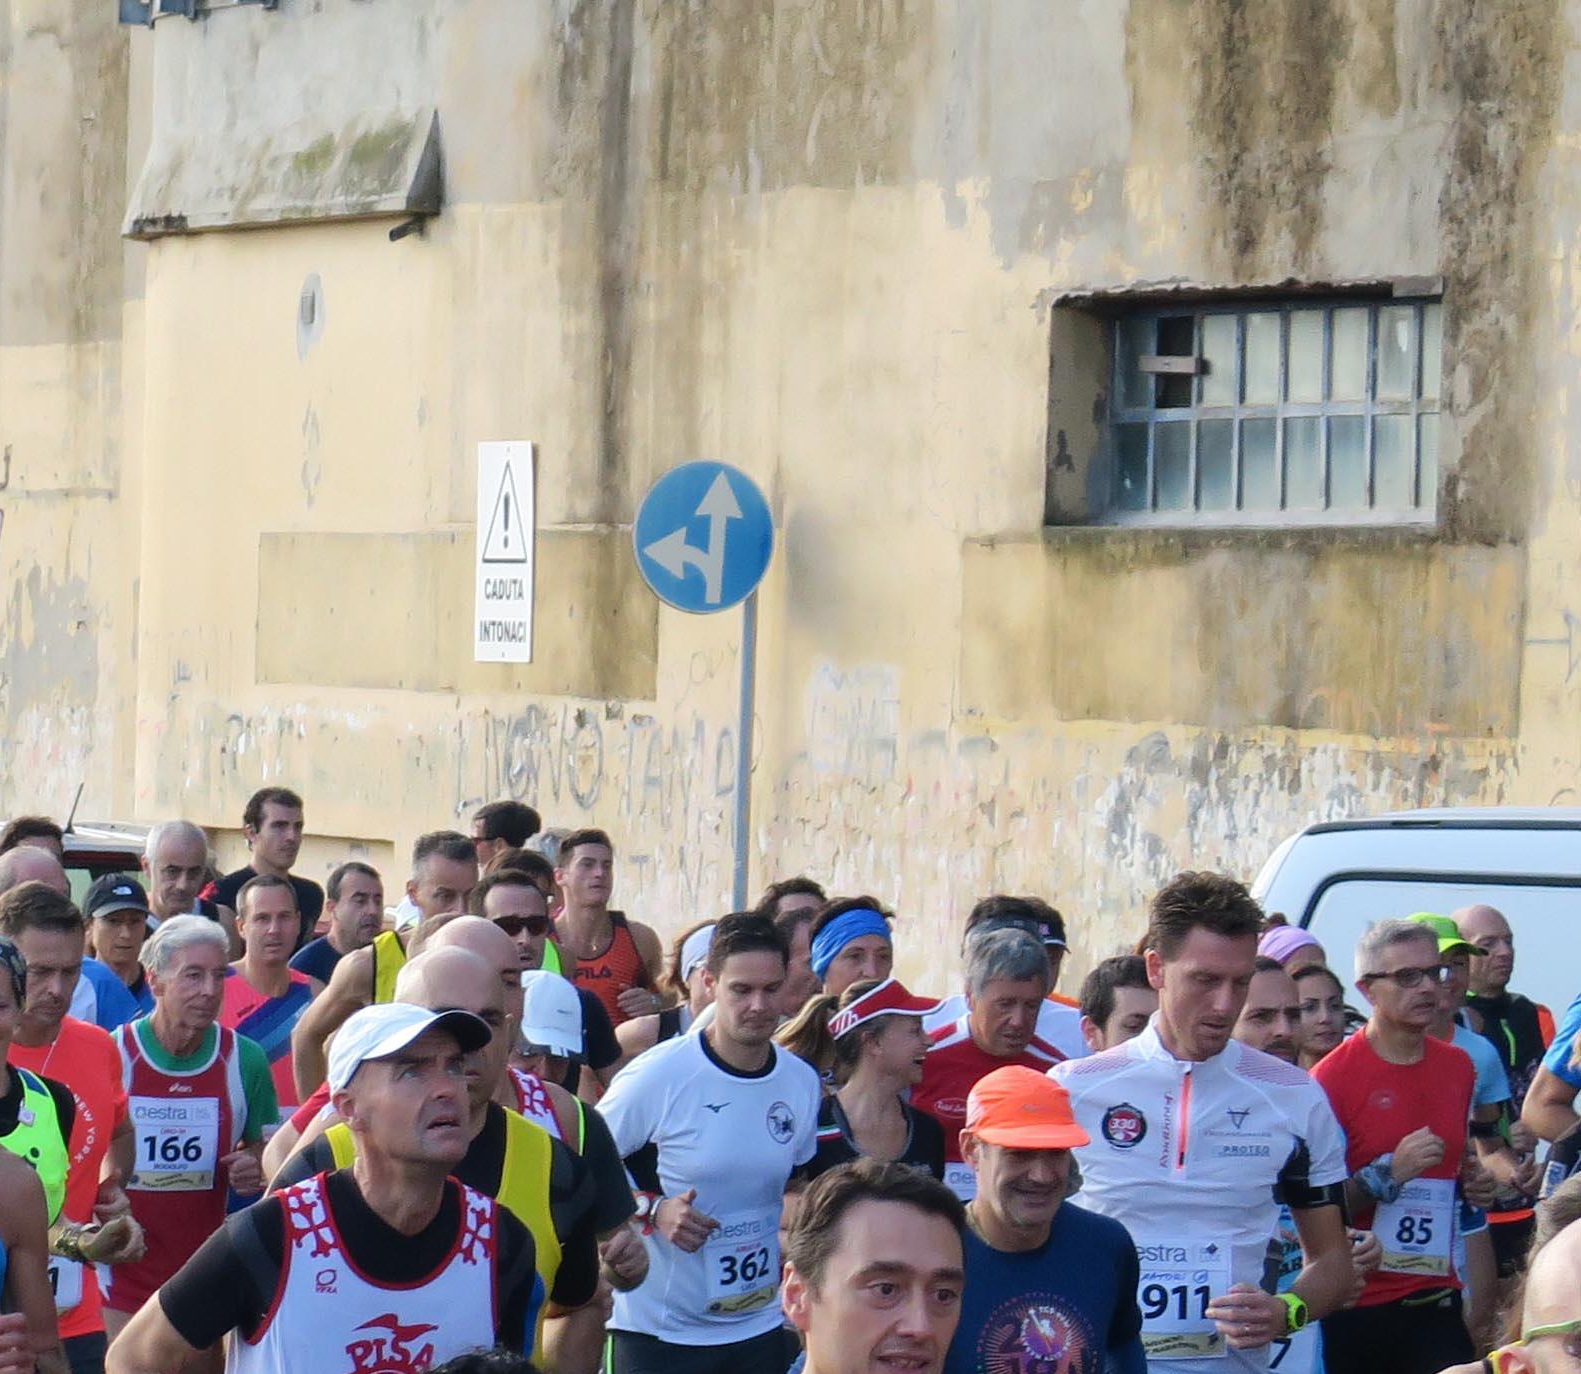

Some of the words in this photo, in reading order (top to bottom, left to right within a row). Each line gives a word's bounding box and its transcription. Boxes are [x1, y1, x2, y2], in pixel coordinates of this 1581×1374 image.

[484, 578, 524, 601] CADUTA
[479, 620, 526, 643] INTONACI
[146, 1106, 187, 1121] estra
[144, 1135, 202, 1162] 166
[724, 1220, 761, 1238] estra
[1396, 1216, 1433, 1244] 85
[719, 1247, 769, 1286] 362
[345, 1330, 436, 1371] PISA
